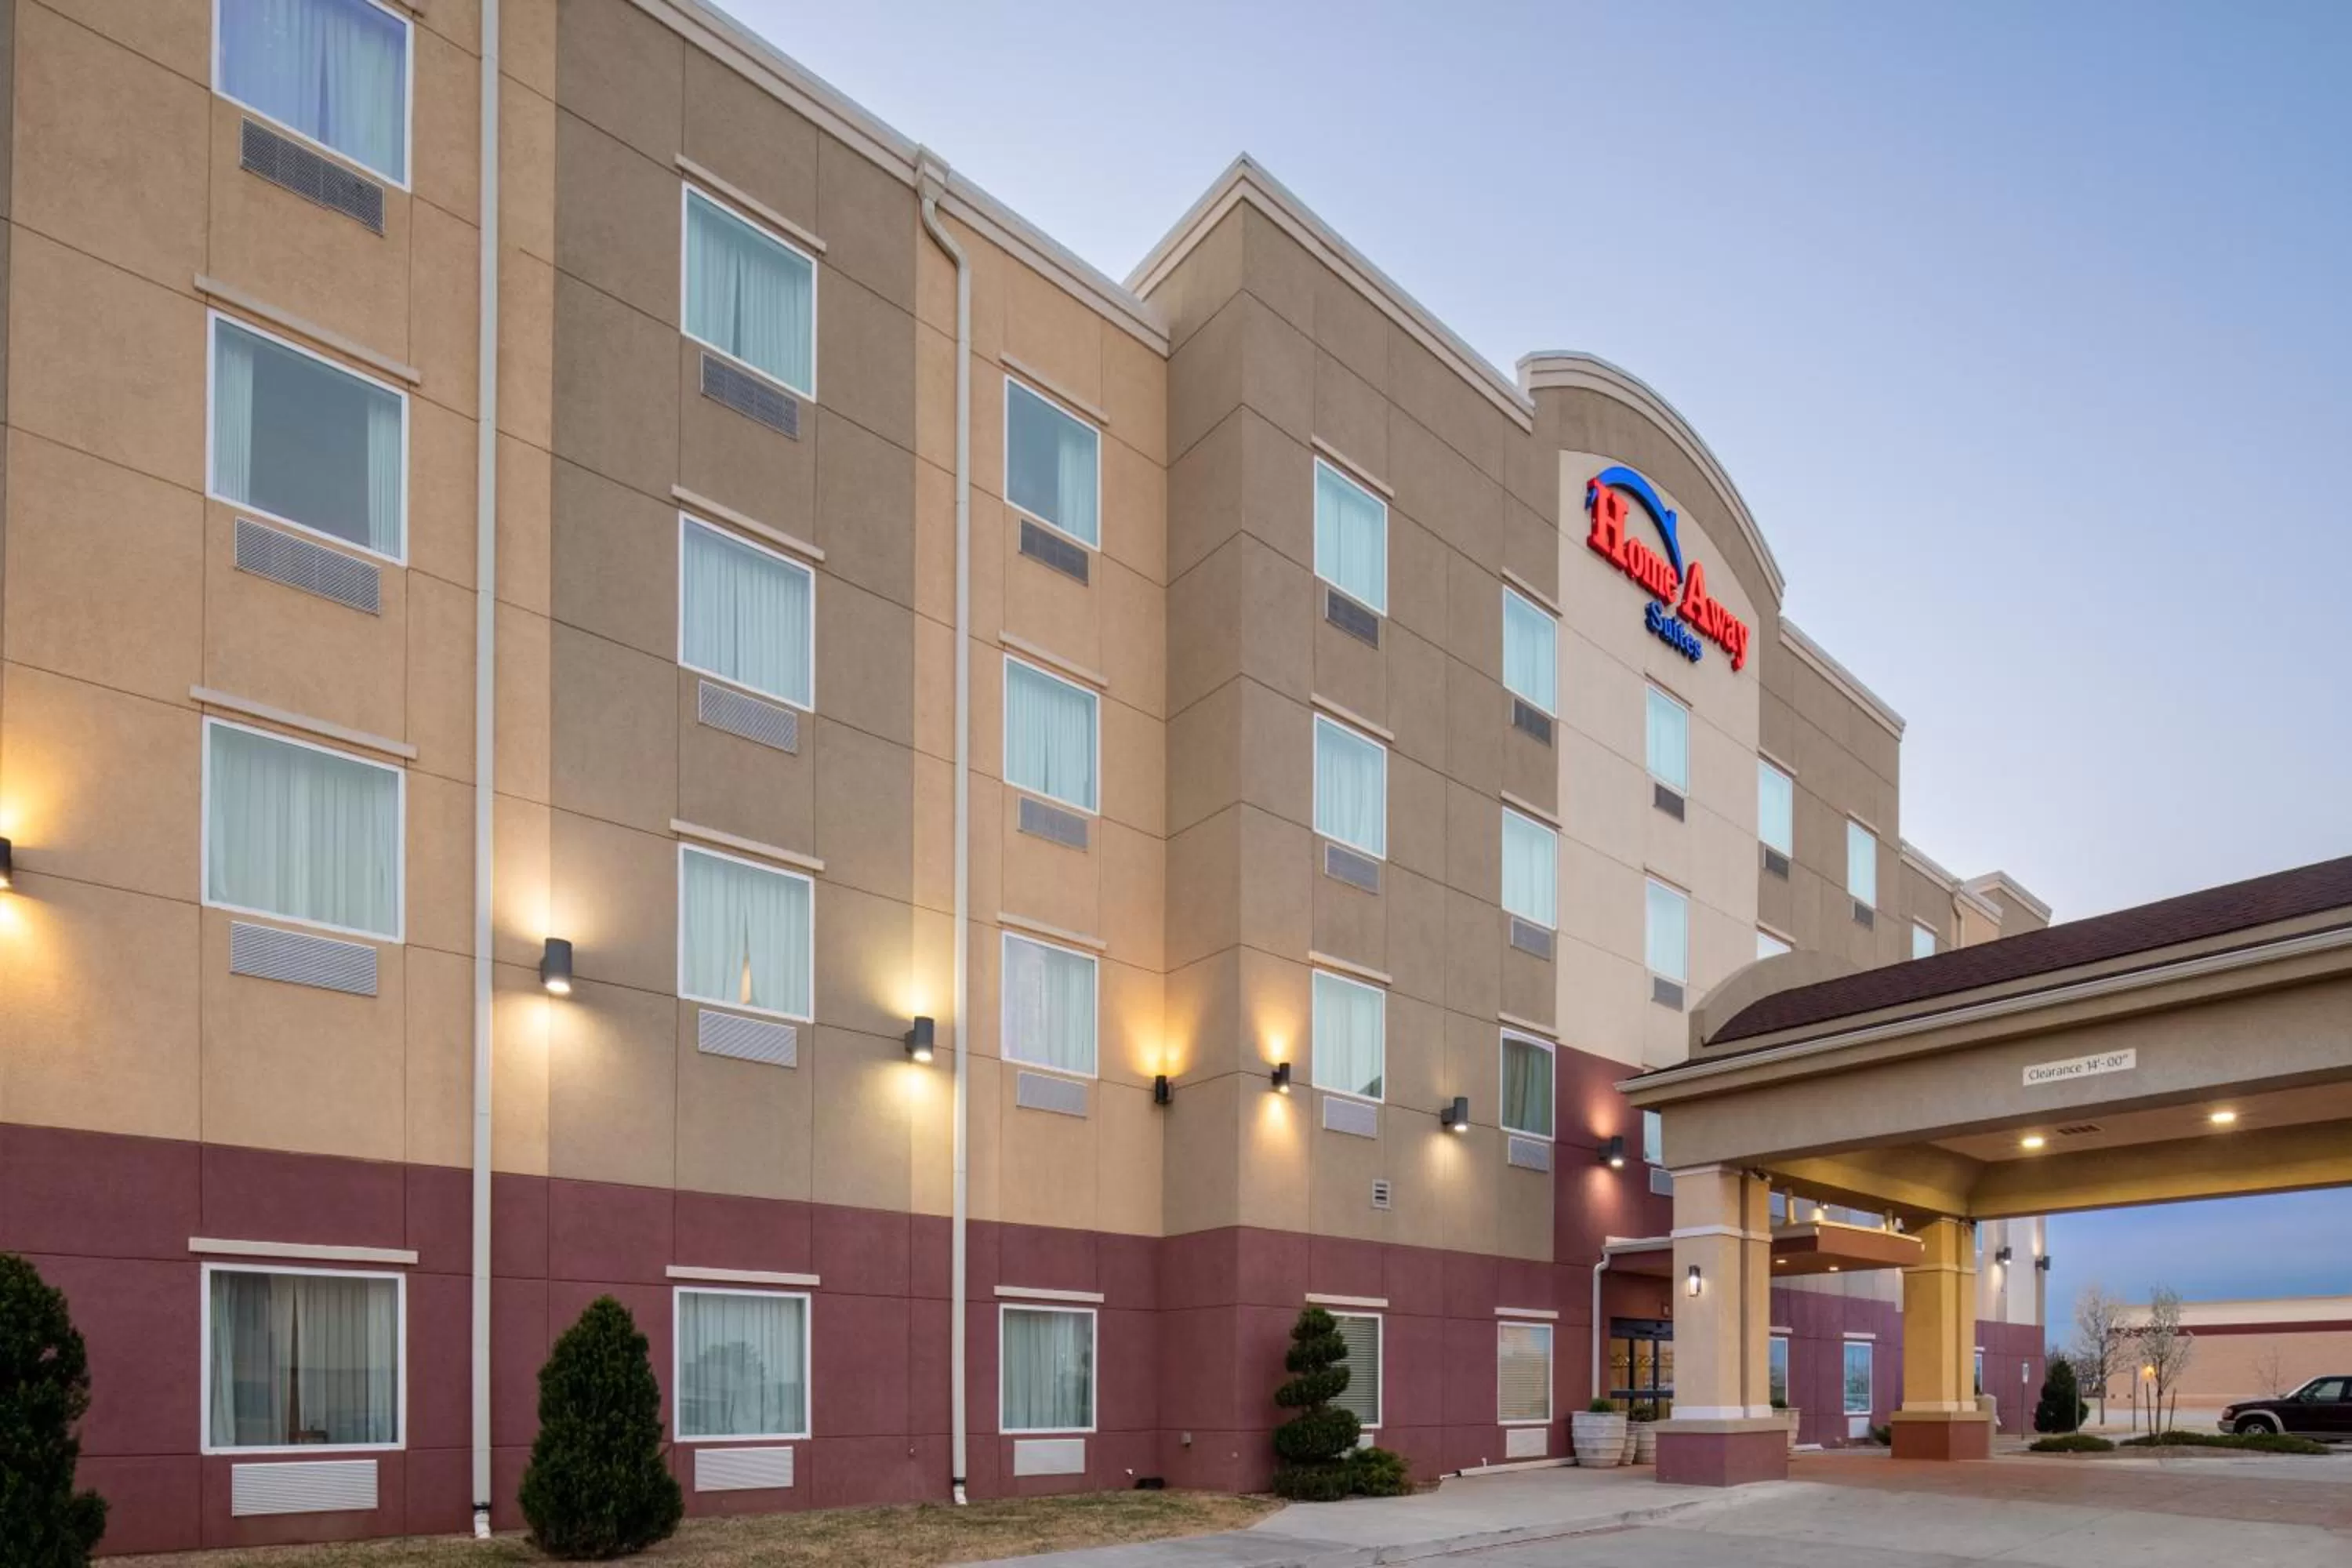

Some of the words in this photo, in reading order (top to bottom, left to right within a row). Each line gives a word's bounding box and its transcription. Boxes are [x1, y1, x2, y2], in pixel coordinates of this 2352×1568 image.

[1587, 477, 1678, 606] Home
[1676, 558, 1751, 672] Away
[1645, 600, 1704, 663] Suites
[2028, 1064, 2082, 1080] Clearance
